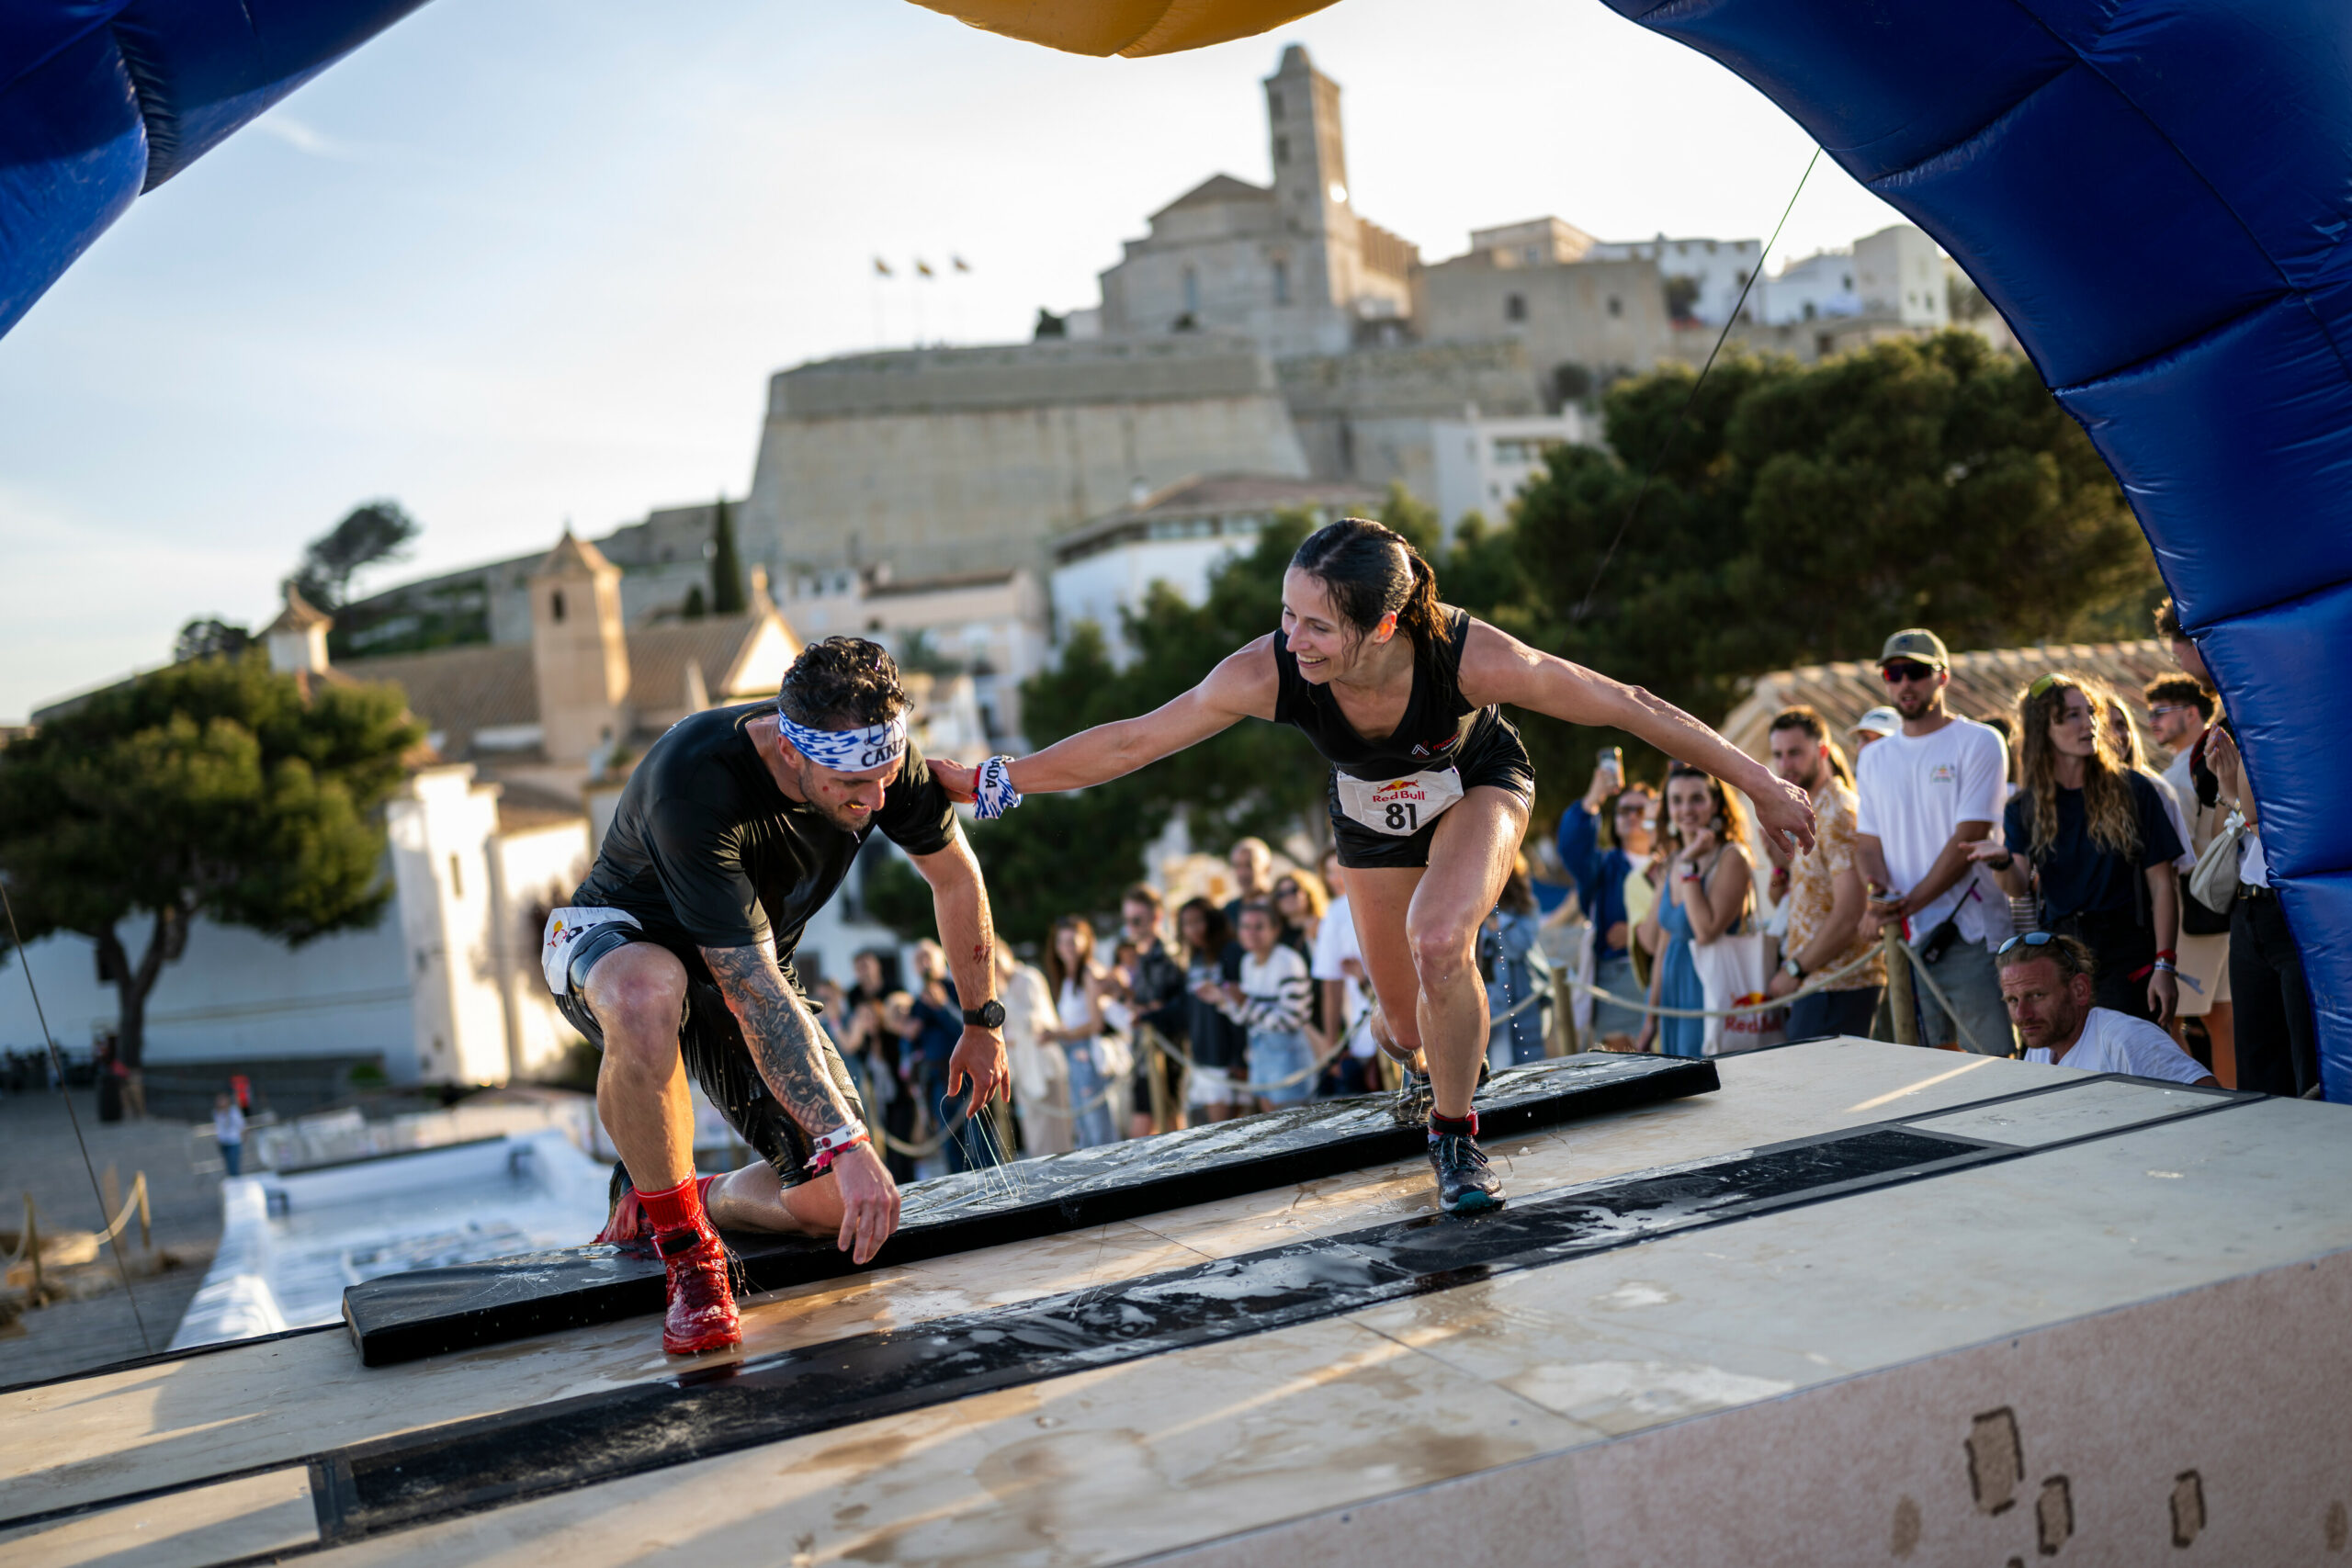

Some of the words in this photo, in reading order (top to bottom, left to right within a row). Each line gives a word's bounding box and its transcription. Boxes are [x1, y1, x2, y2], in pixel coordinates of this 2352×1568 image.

[1373, 792, 1398, 803] Red
[1400, 791, 1425, 801] Bull
[1385, 803, 1418, 830] 81
[1724, 1015, 1758, 1033] Red
